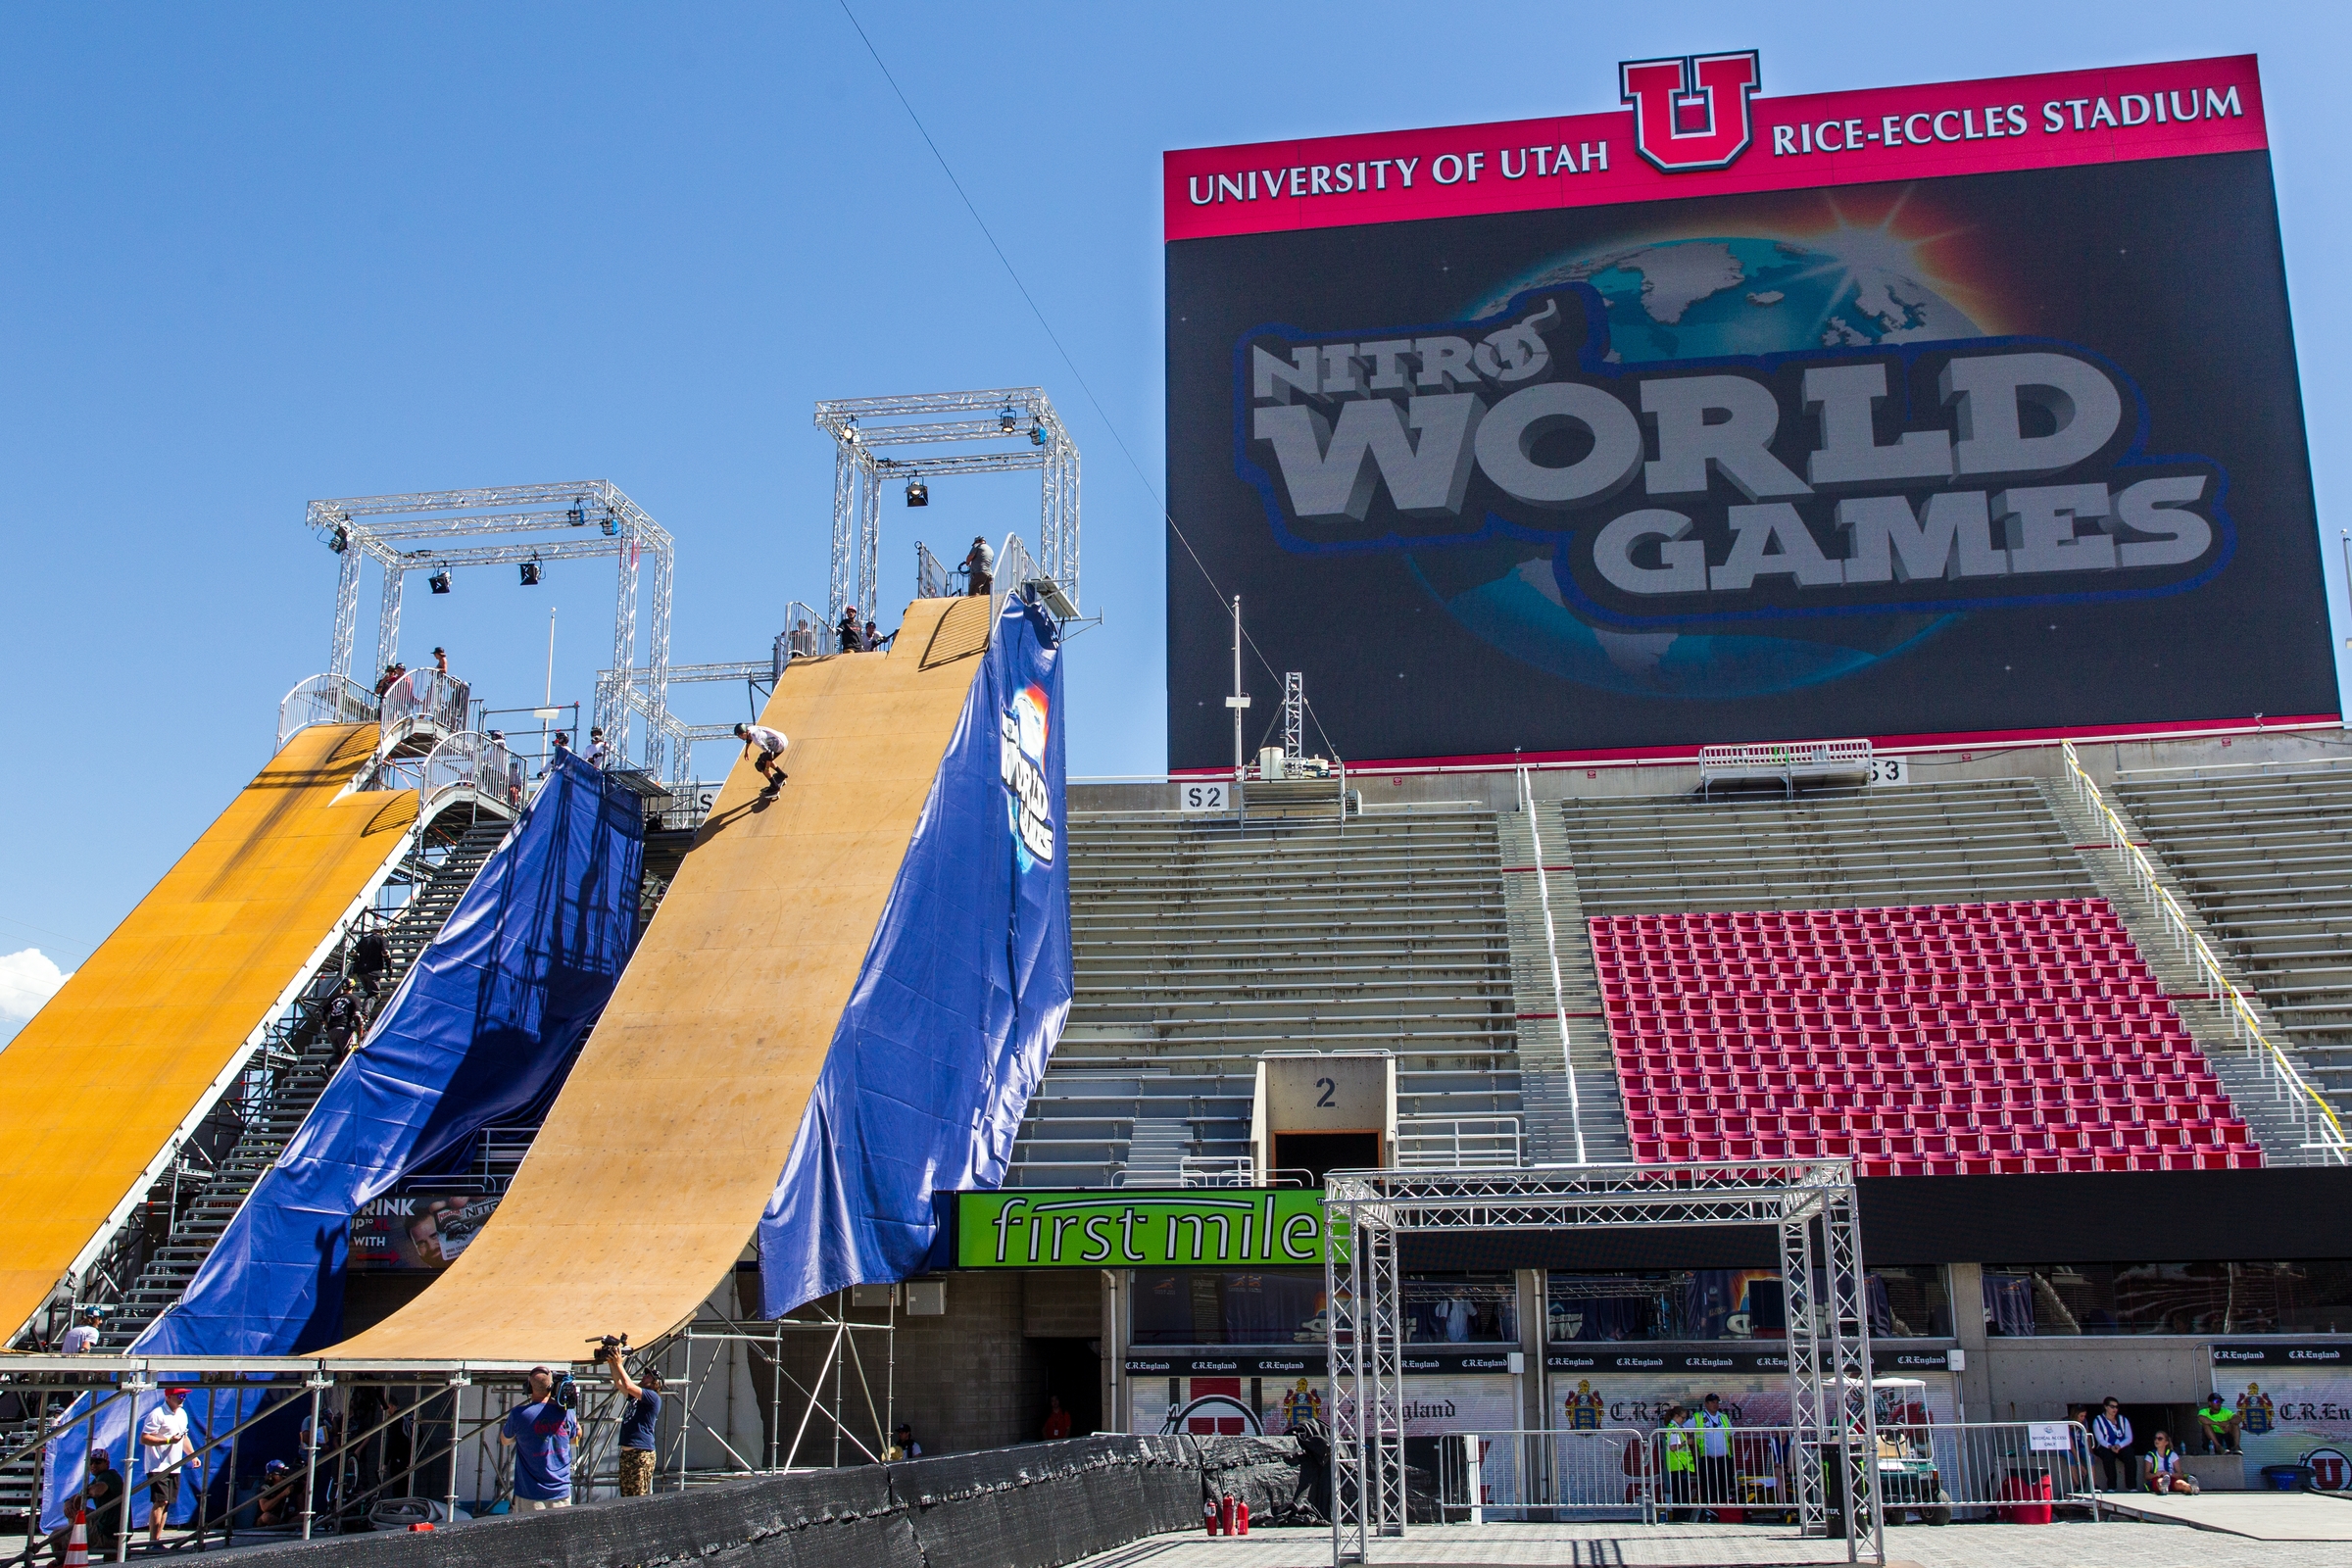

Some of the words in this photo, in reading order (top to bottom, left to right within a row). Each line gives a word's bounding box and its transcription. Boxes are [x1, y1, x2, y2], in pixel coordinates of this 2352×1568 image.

[1619, 49, 1762, 173] U
[1773, 105, 2028, 157] RICE-ECCLES
[2042, 85, 2243, 134] STADIUM
[1189, 158, 1420, 206] UNIVERSITY
[1432, 151, 1486, 185] OF
[1500, 140, 1609, 179] UTAH
[1253, 299, 1559, 404] NITRO
[1254, 352, 2121, 521] WORLD
[1593, 475, 2212, 595] GAMES
[1188, 787, 1221, 808] S2
[1316, 1077, 1336, 1107] 2
[356, 1198, 416, 1217] RINK
[372, 1218, 391, 1232] XL
[992, 1197, 1149, 1263] first
[1164, 1194, 1318, 1260] mile
[354, 1236, 386, 1247] WITH
[2311, 1457, 2343, 1490] U
